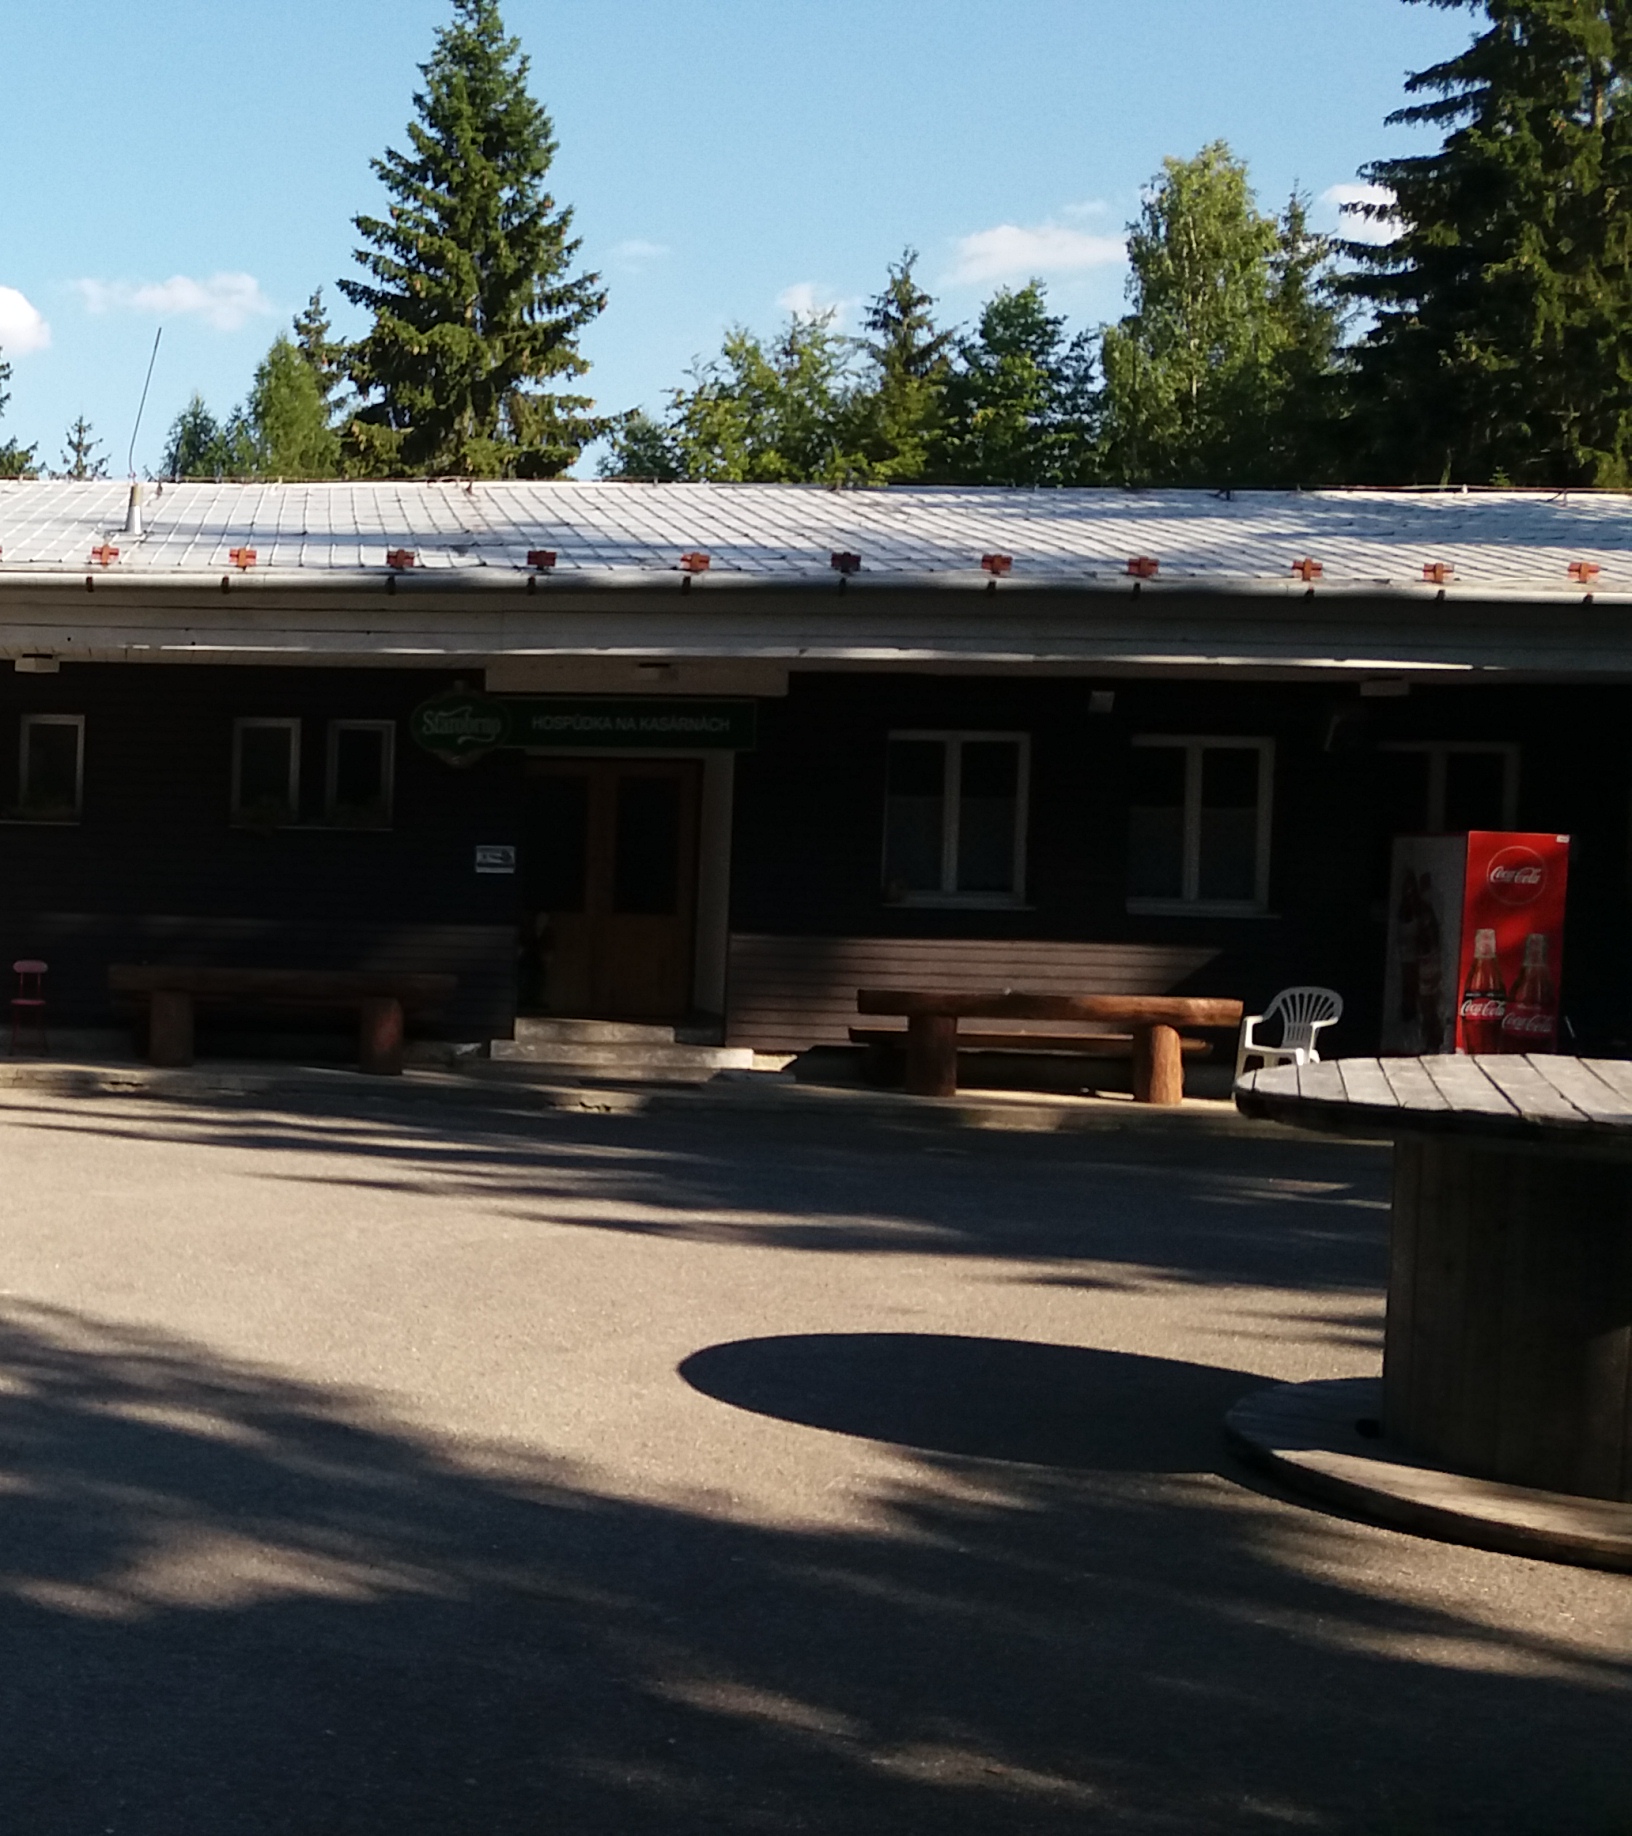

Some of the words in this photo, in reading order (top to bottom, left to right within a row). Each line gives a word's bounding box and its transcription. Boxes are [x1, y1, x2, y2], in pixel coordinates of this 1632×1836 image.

[422, 705, 503, 744] Starobrno
[532, 713, 613, 732] HOSPŮDKA
[616, 716, 636, 732] NA
[639, 714, 731, 733] KASÁRNÁCH
